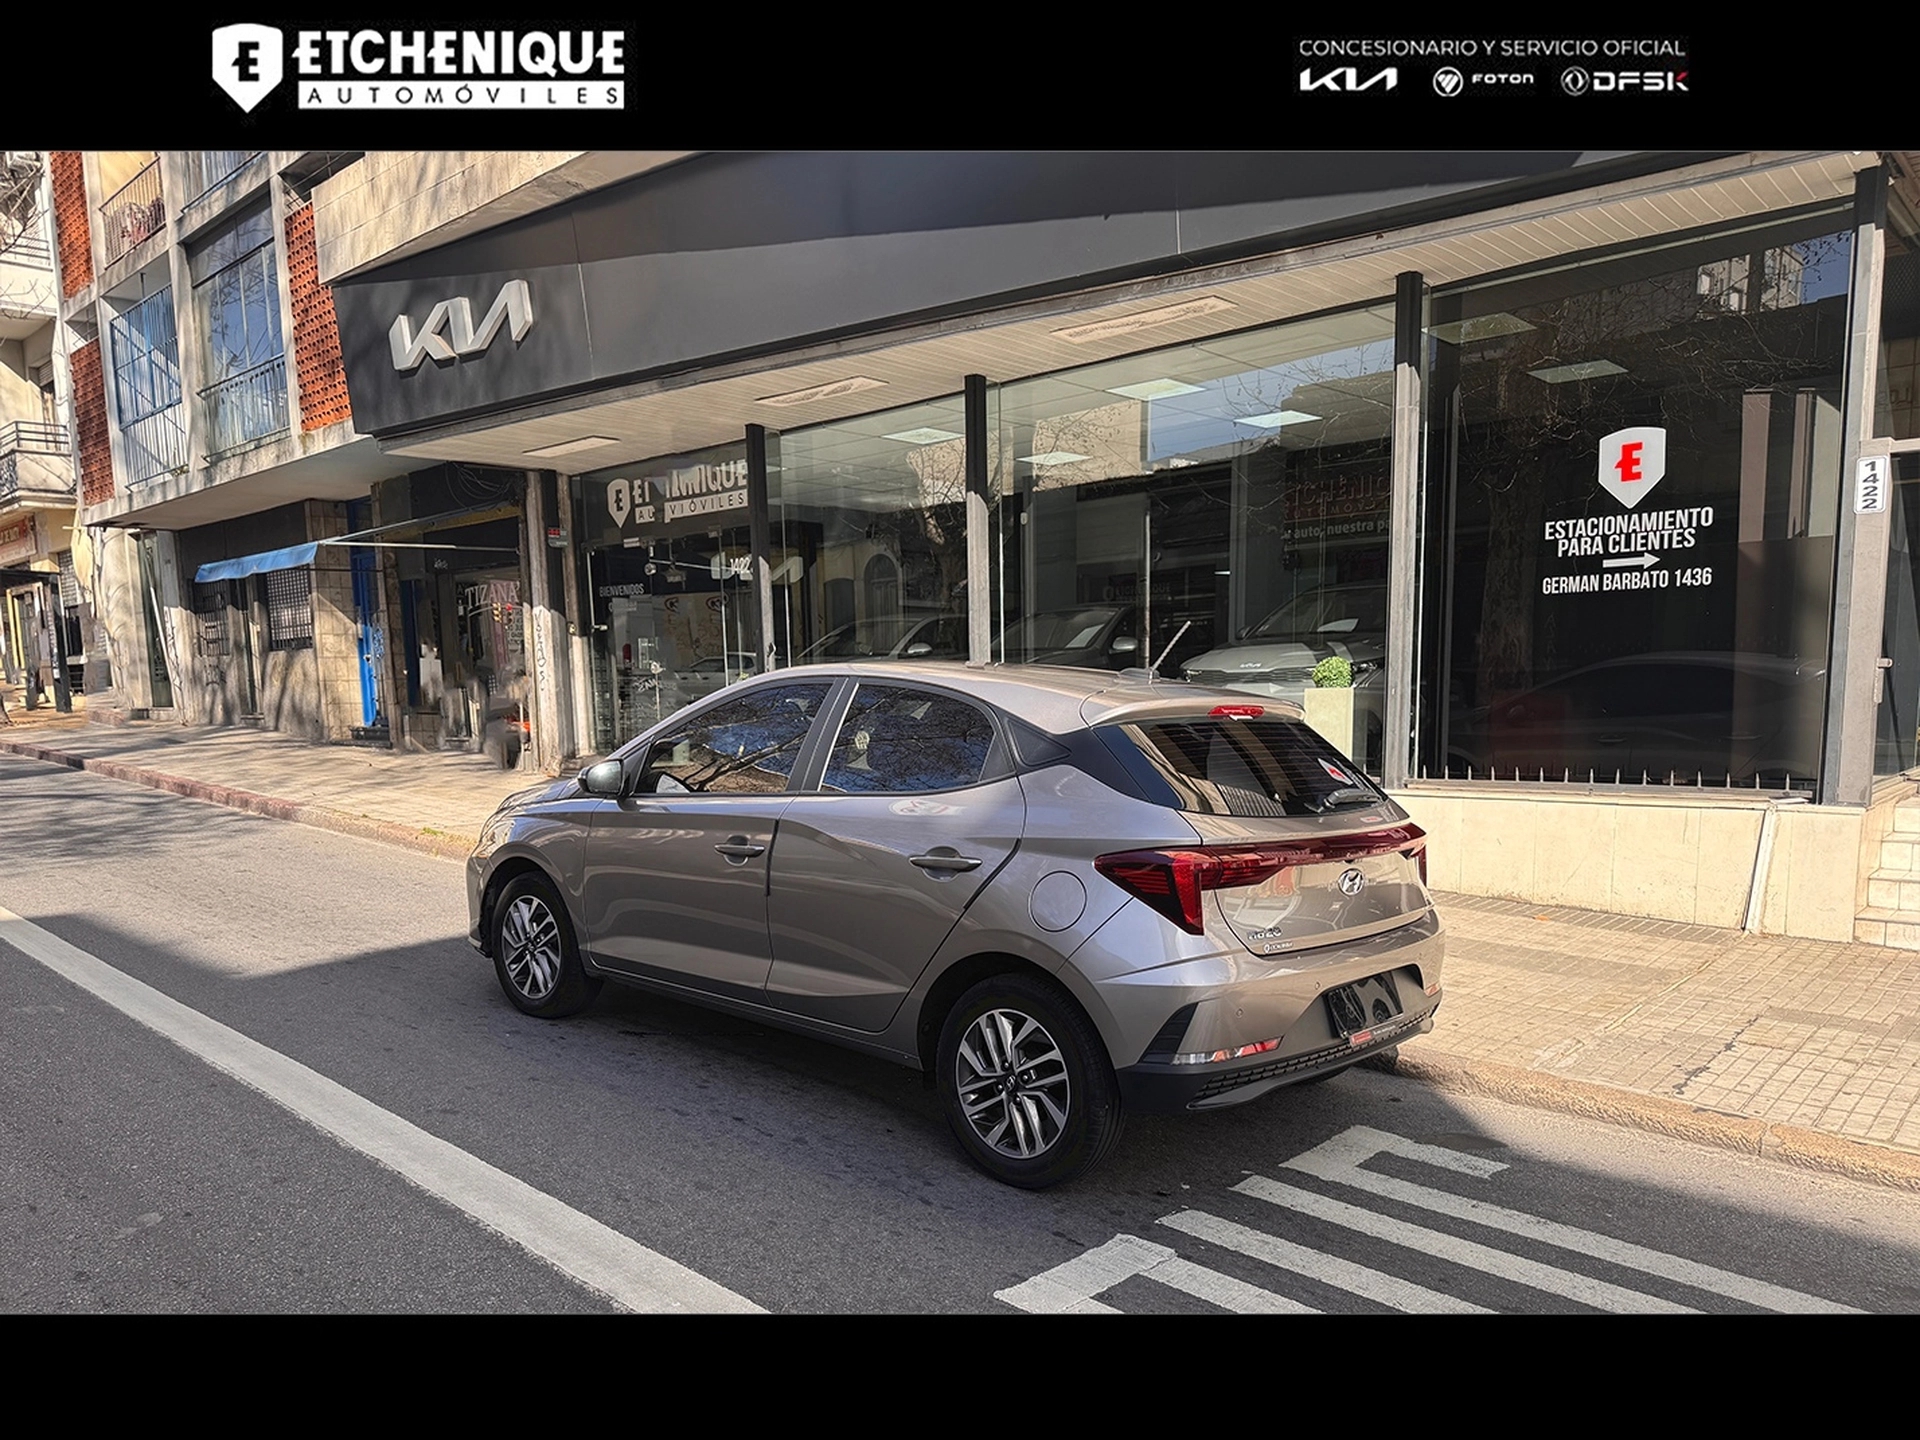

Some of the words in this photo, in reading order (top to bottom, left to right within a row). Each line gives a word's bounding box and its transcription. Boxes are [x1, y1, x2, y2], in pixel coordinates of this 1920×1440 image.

[388, 279, 534, 372] KIA
[1862, 461, 1880, 509] 1422
[1544, 506, 1714, 541] ESTACIONAMIENTO
[1557, 537, 1604, 558] PARA
[1608, 527, 1696, 554] CLIENTES
[1542, 574, 1600, 595] GERMAN
[1602, 569, 1670, 592] BARBATO
[1674, 567, 1713, 588] 1436
